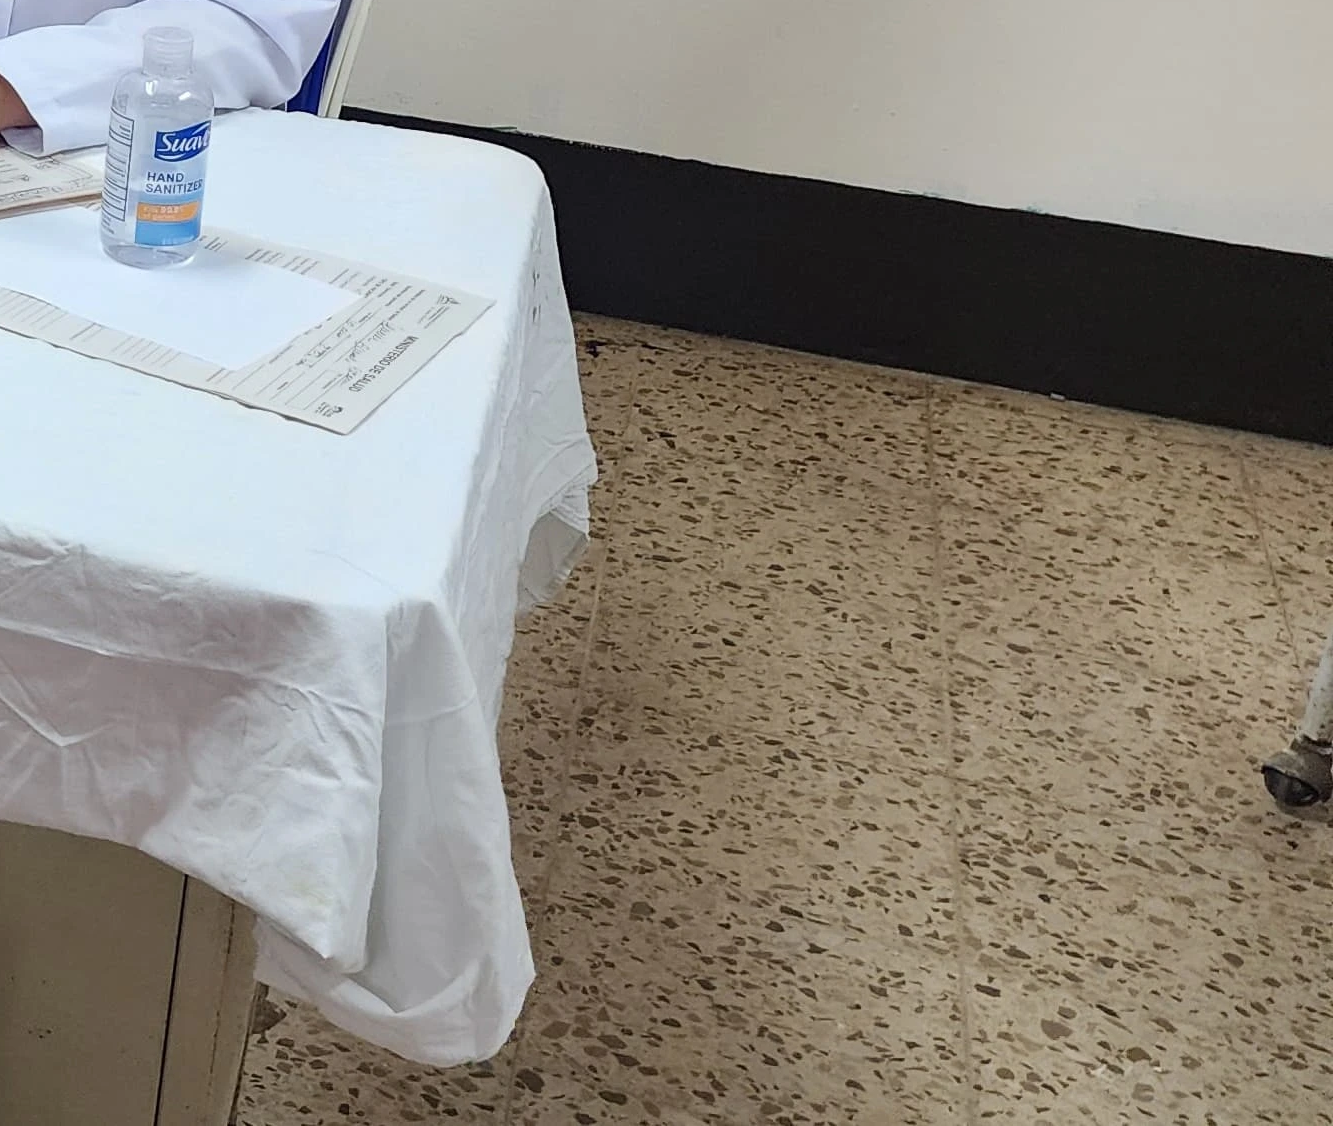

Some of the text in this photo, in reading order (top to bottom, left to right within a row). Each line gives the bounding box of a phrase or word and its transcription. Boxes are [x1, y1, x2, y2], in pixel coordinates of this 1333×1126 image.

[147, 172, 185, 183] HAND
[145, 179, 203, 195] SANITIZER
[379, 335, 419, 365] MINISTERIO
[373, 364, 385, 374] DE
[349, 368, 375, 393] SALUD
